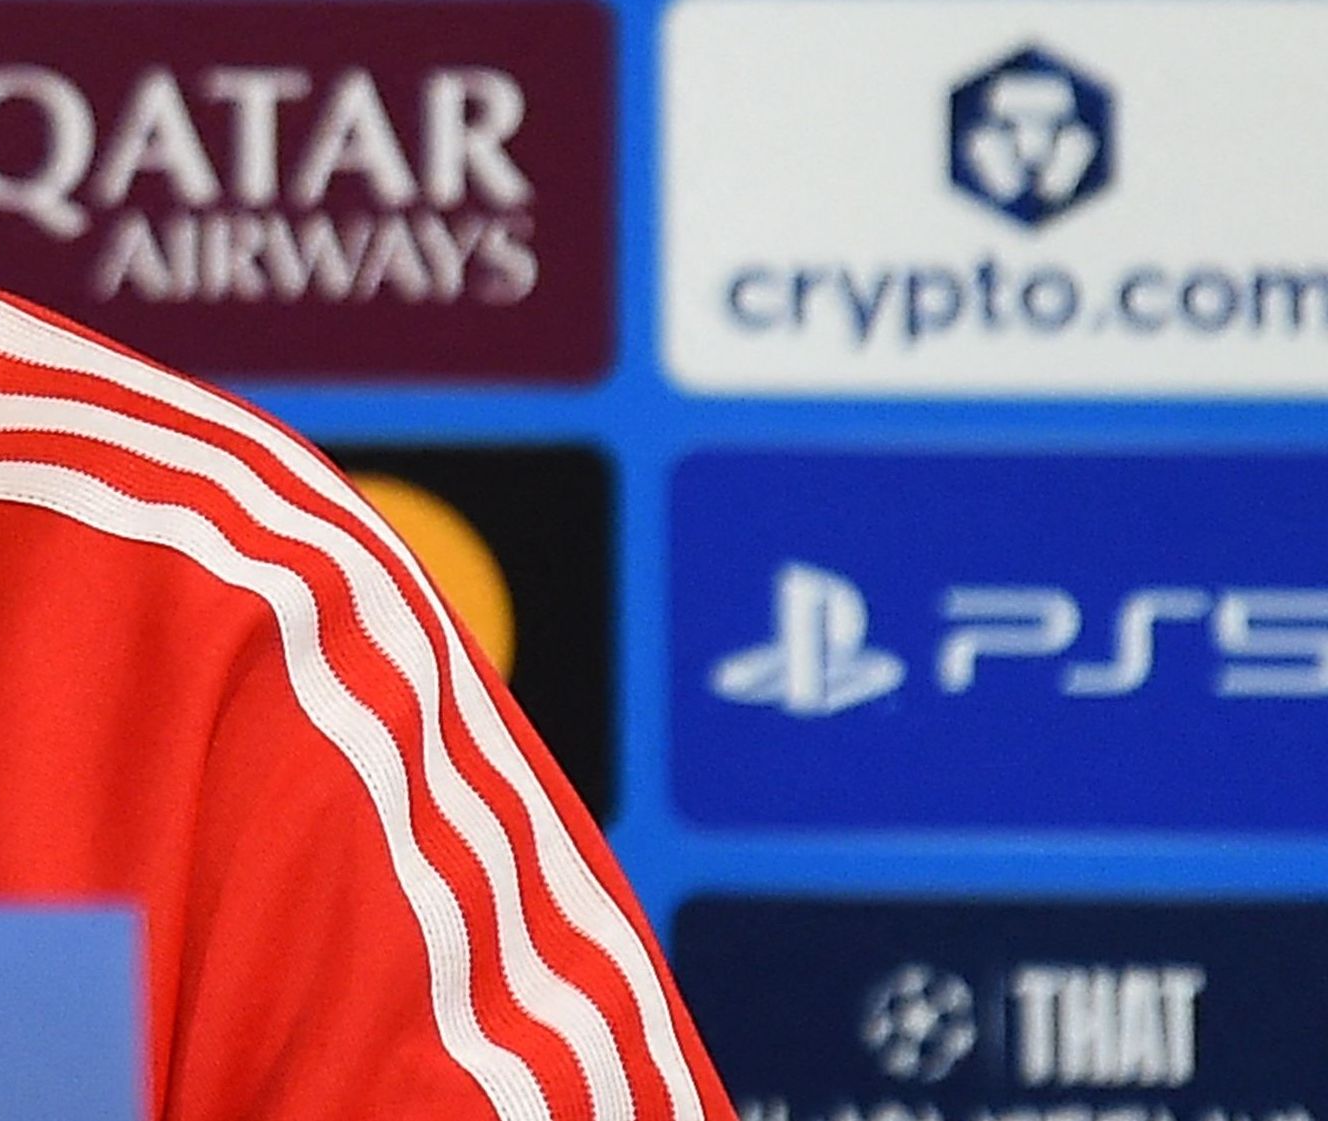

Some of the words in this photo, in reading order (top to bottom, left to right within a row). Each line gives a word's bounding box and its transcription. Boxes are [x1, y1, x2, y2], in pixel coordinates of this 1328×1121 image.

[96, 212, 540, 304] AIRWAYS
[724, 256, 1328, 350] crypto.com
[936, 586, 1328, 698] PS5
[1014, 962, 1208, 1087] THAT
